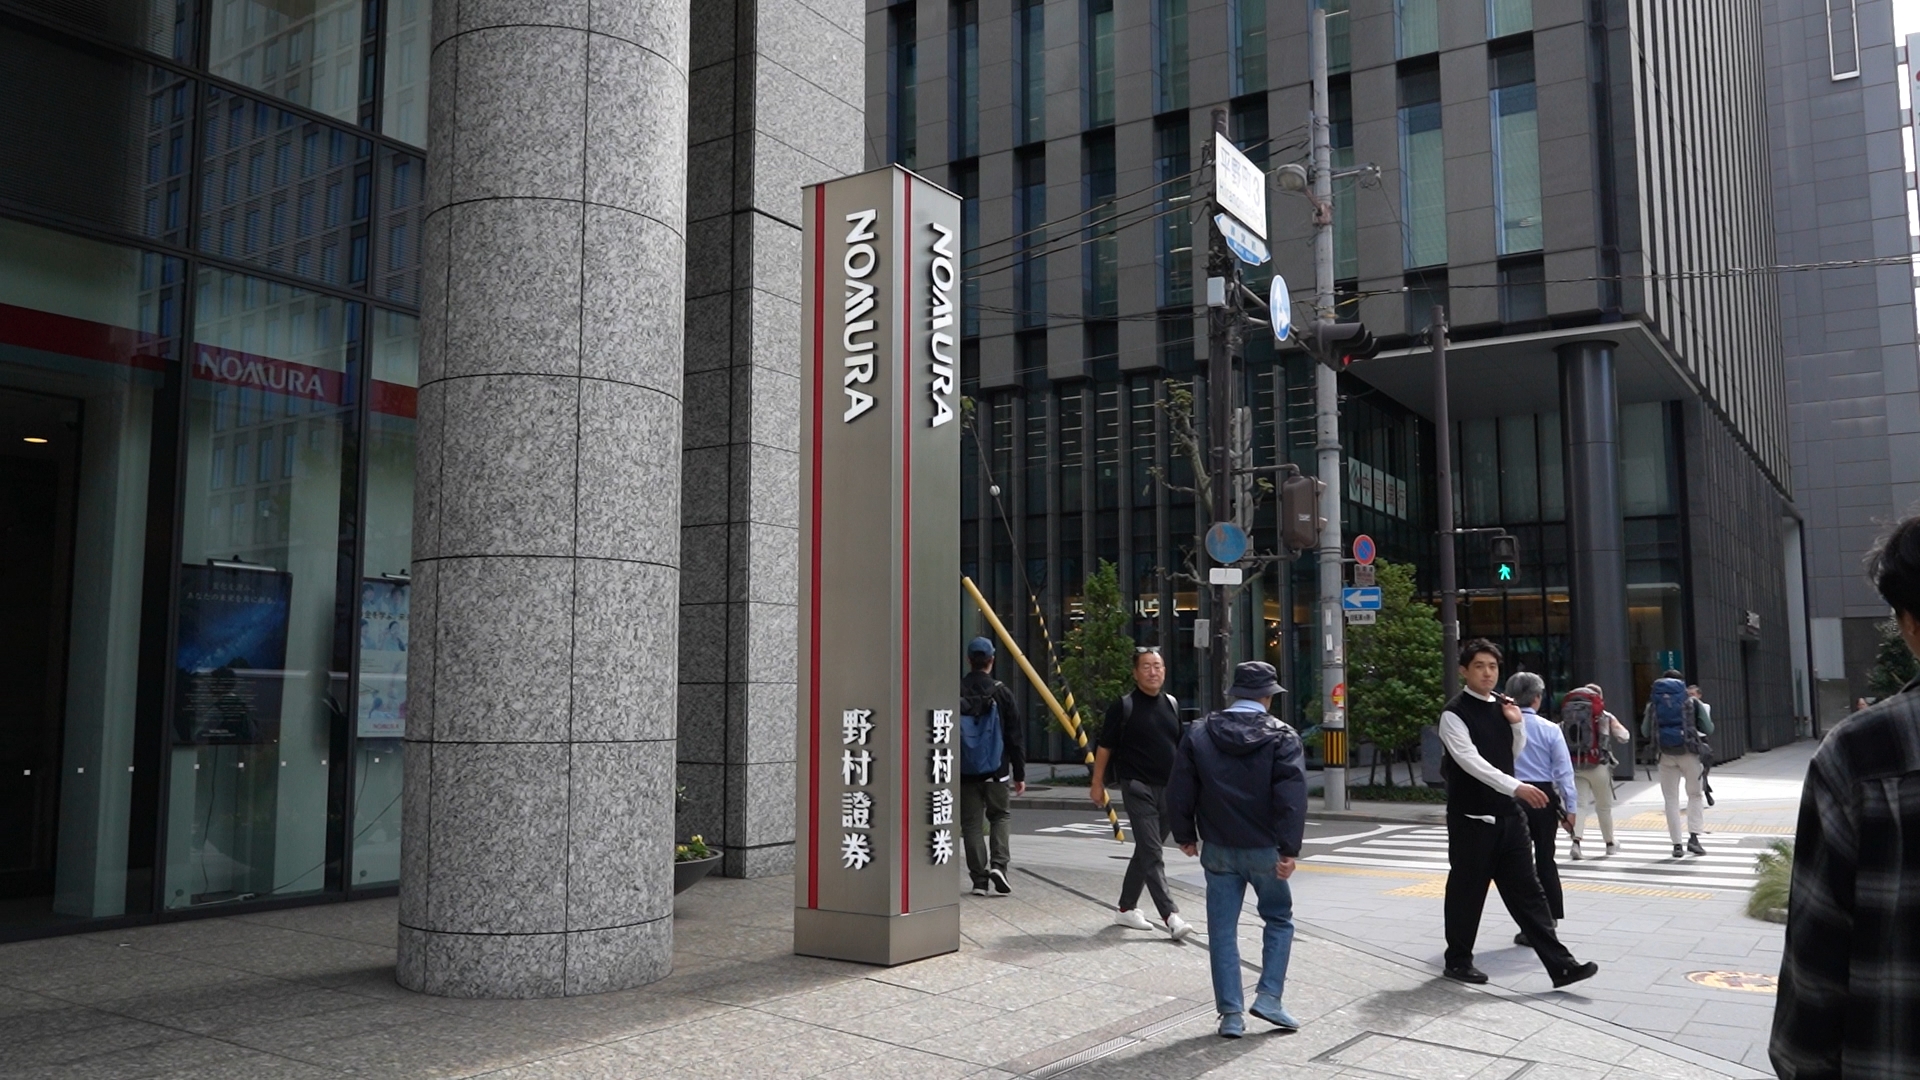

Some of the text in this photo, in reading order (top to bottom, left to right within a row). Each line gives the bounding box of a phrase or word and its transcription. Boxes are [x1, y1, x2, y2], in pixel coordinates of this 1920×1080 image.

[199, 351, 325, 398] NOMURA
[844, 209, 876, 423] NOMURA
[930, 222, 954, 428] NOMURA
[841, 708, 872, 870] 野村證券
[932, 709, 954, 866] 野村證券
